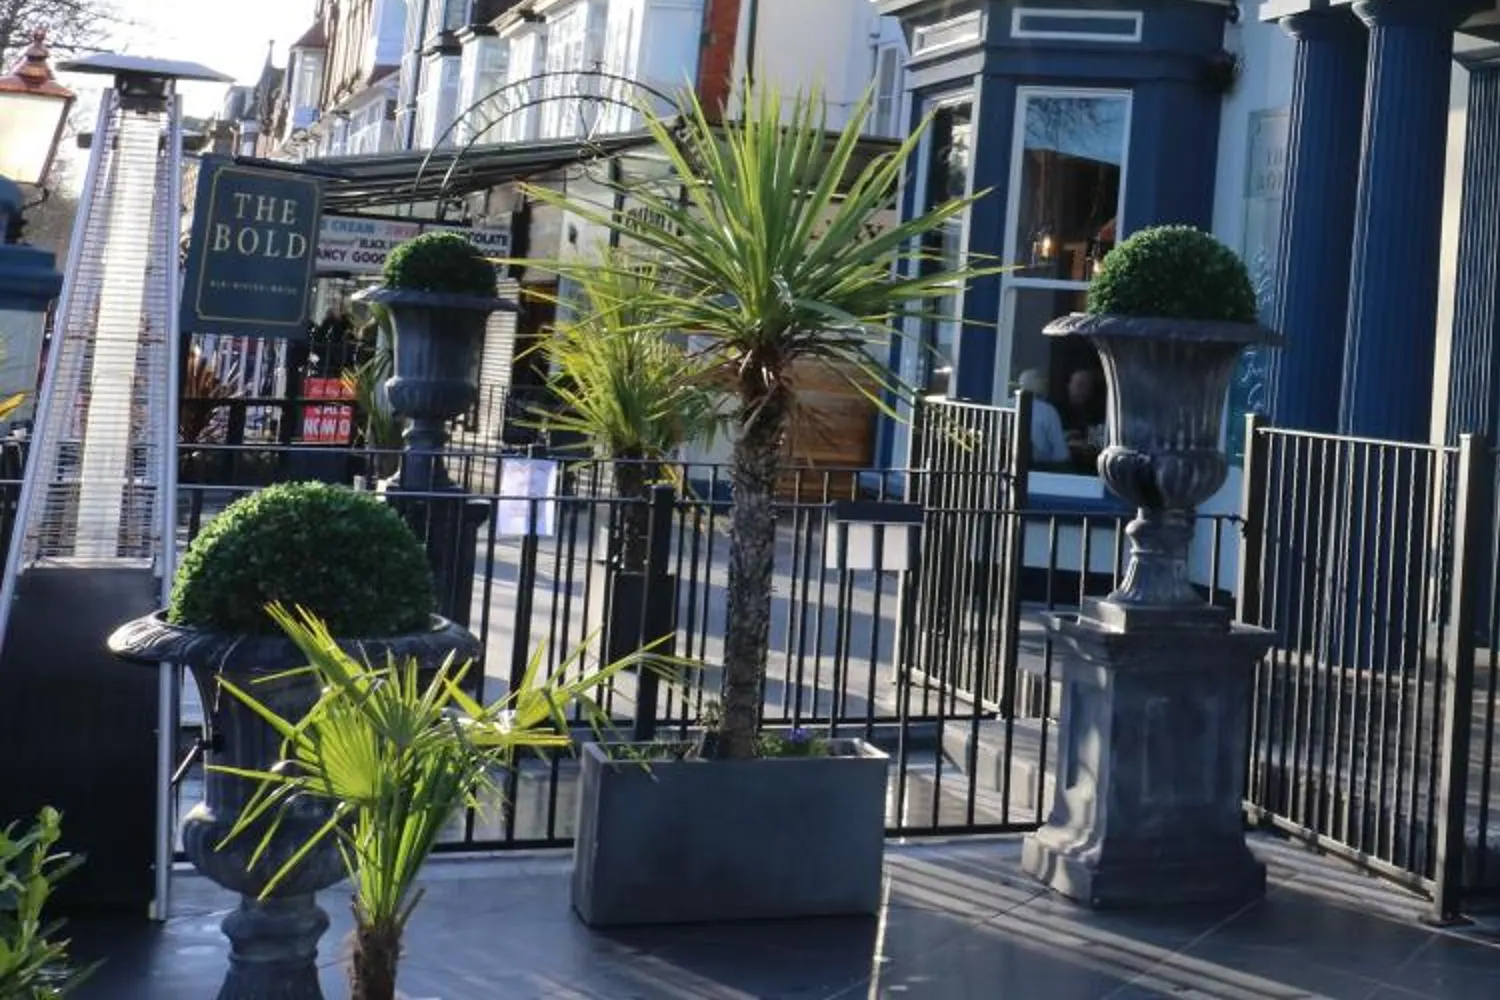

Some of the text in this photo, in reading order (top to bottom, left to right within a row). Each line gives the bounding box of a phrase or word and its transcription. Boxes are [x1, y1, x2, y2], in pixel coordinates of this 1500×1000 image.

[233, 191, 298, 225] THE
[211, 222, 308, 260] BOLD
[315, 247, 347, 262] ANCY
